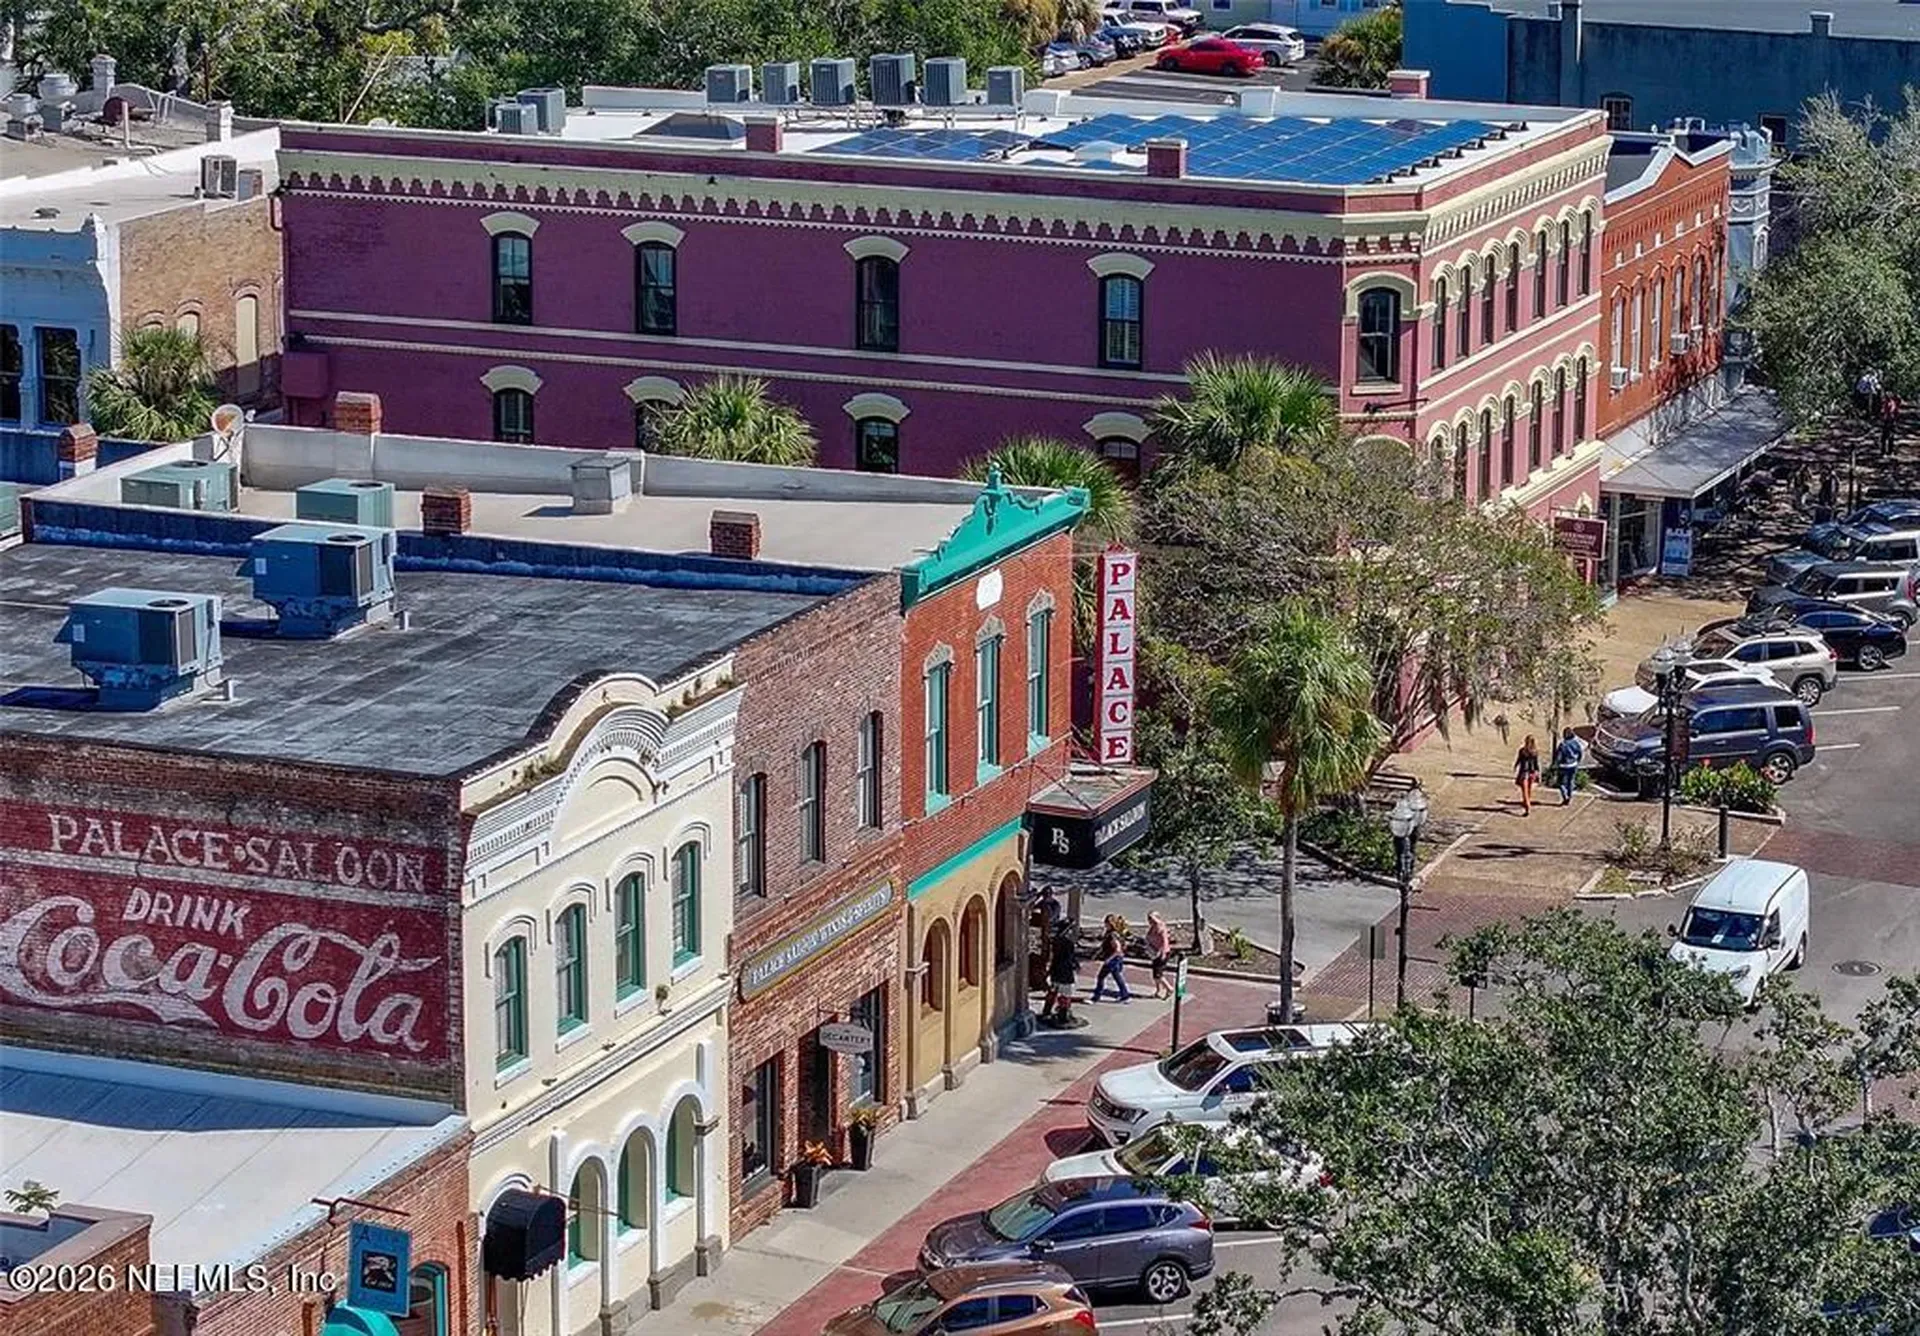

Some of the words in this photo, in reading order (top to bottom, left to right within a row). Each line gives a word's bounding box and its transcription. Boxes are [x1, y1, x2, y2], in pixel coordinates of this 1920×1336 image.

[1105, 562, 1131, 760] PALACE
[48, 812, 230, 870] PALACE
[244, 836, 427, 893] SALOON
[123, 887, 251, 940] DRINK
[0, 896, 441, 1052] Coca-Cola
